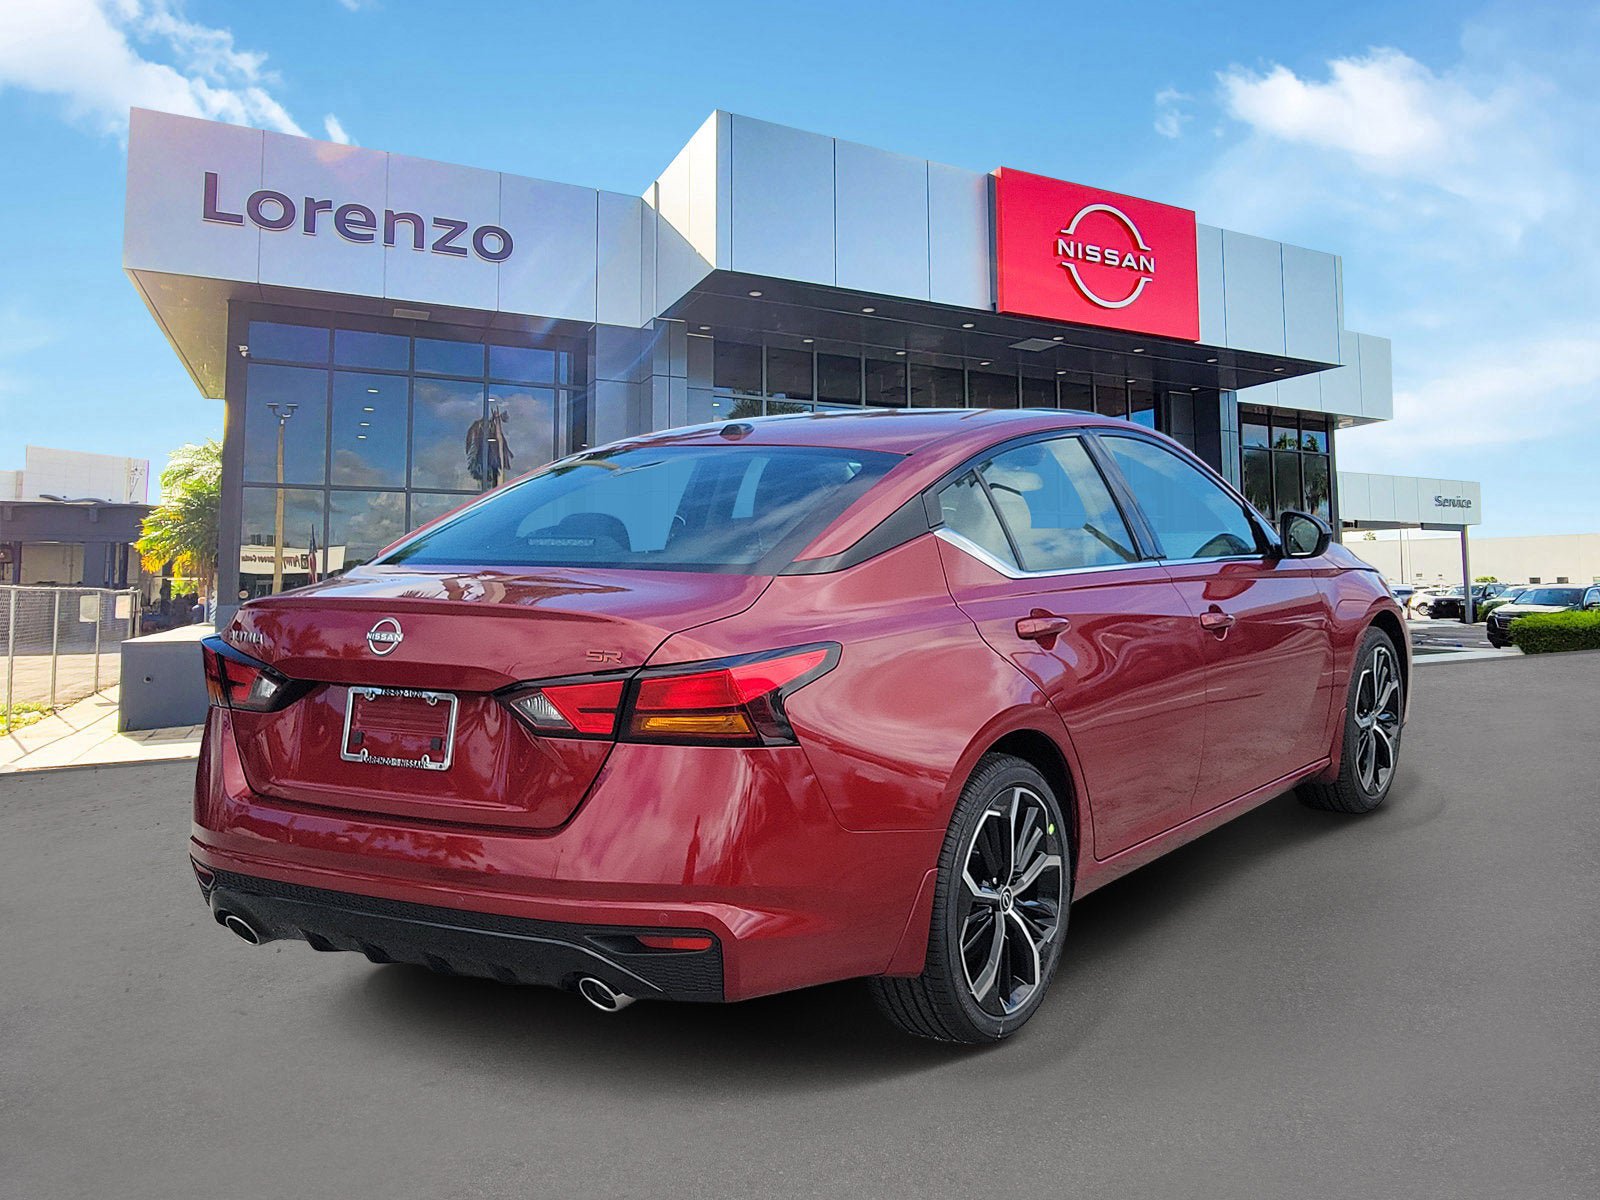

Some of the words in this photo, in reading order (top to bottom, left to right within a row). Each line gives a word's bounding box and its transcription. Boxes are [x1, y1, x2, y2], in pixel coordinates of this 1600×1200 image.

[203, 171, 514, 262] Lorenzo
[1057, 238, 1155, 273] NISSAN
[1434, 495, 1472, 508] Service
[366, 631, 404, 642] NISSAN
[586, 649, 623, 664] SR
